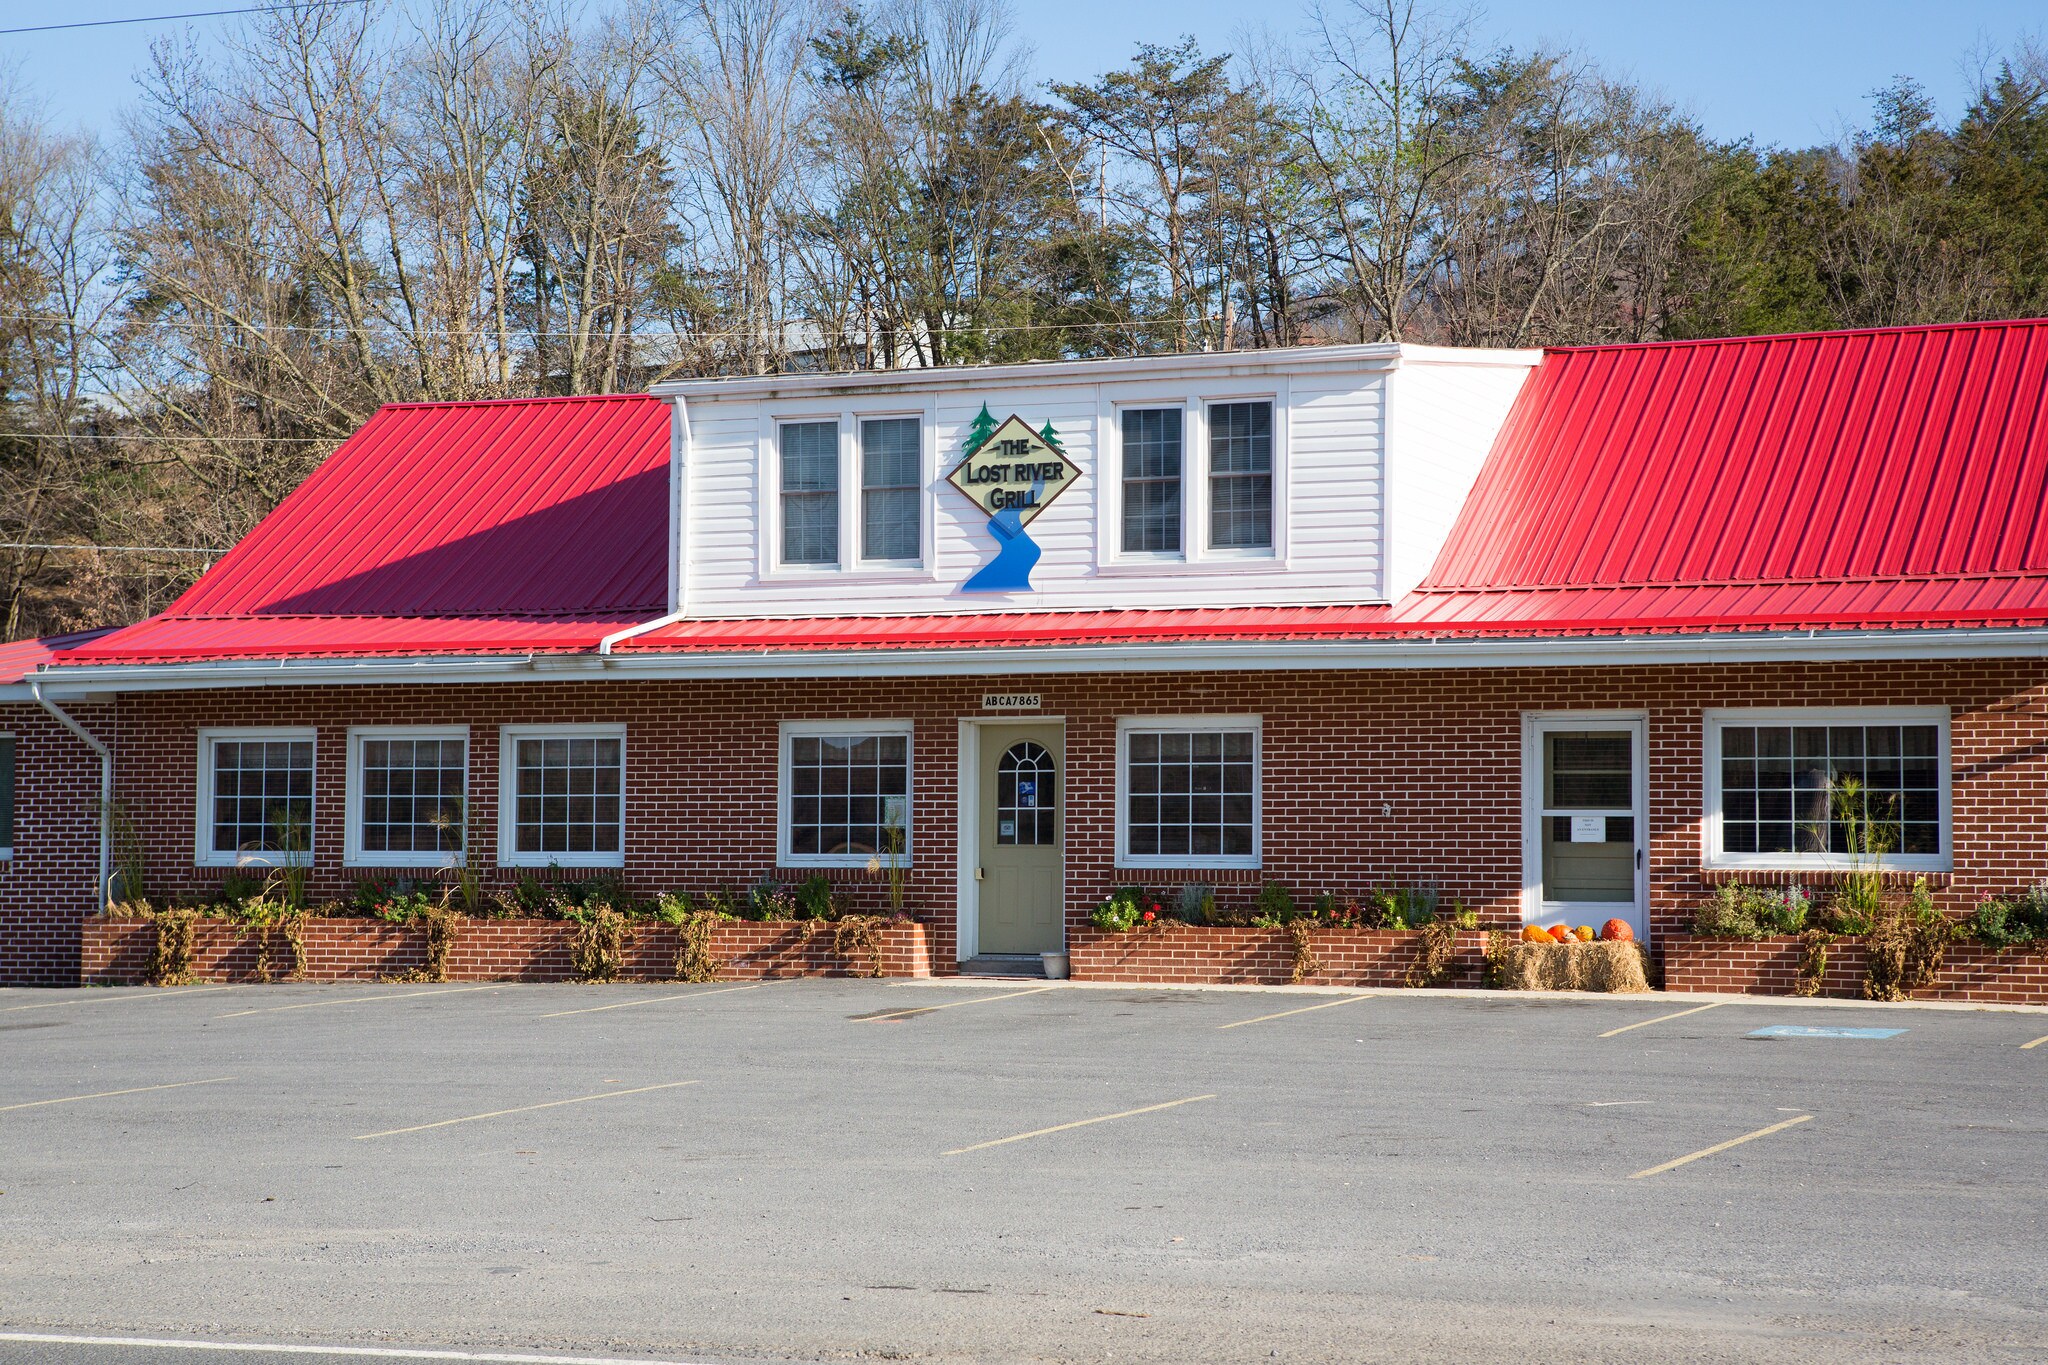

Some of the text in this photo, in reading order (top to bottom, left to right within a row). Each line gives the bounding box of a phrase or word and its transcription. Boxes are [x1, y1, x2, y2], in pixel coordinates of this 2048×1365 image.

[1000, 438, 1030, 456] THE
[966, 461, 1065, 484] LOST RIVER
[990, 487, 1041, 509] GRILL
[985, 695, 1039, 706] ABCA7865
